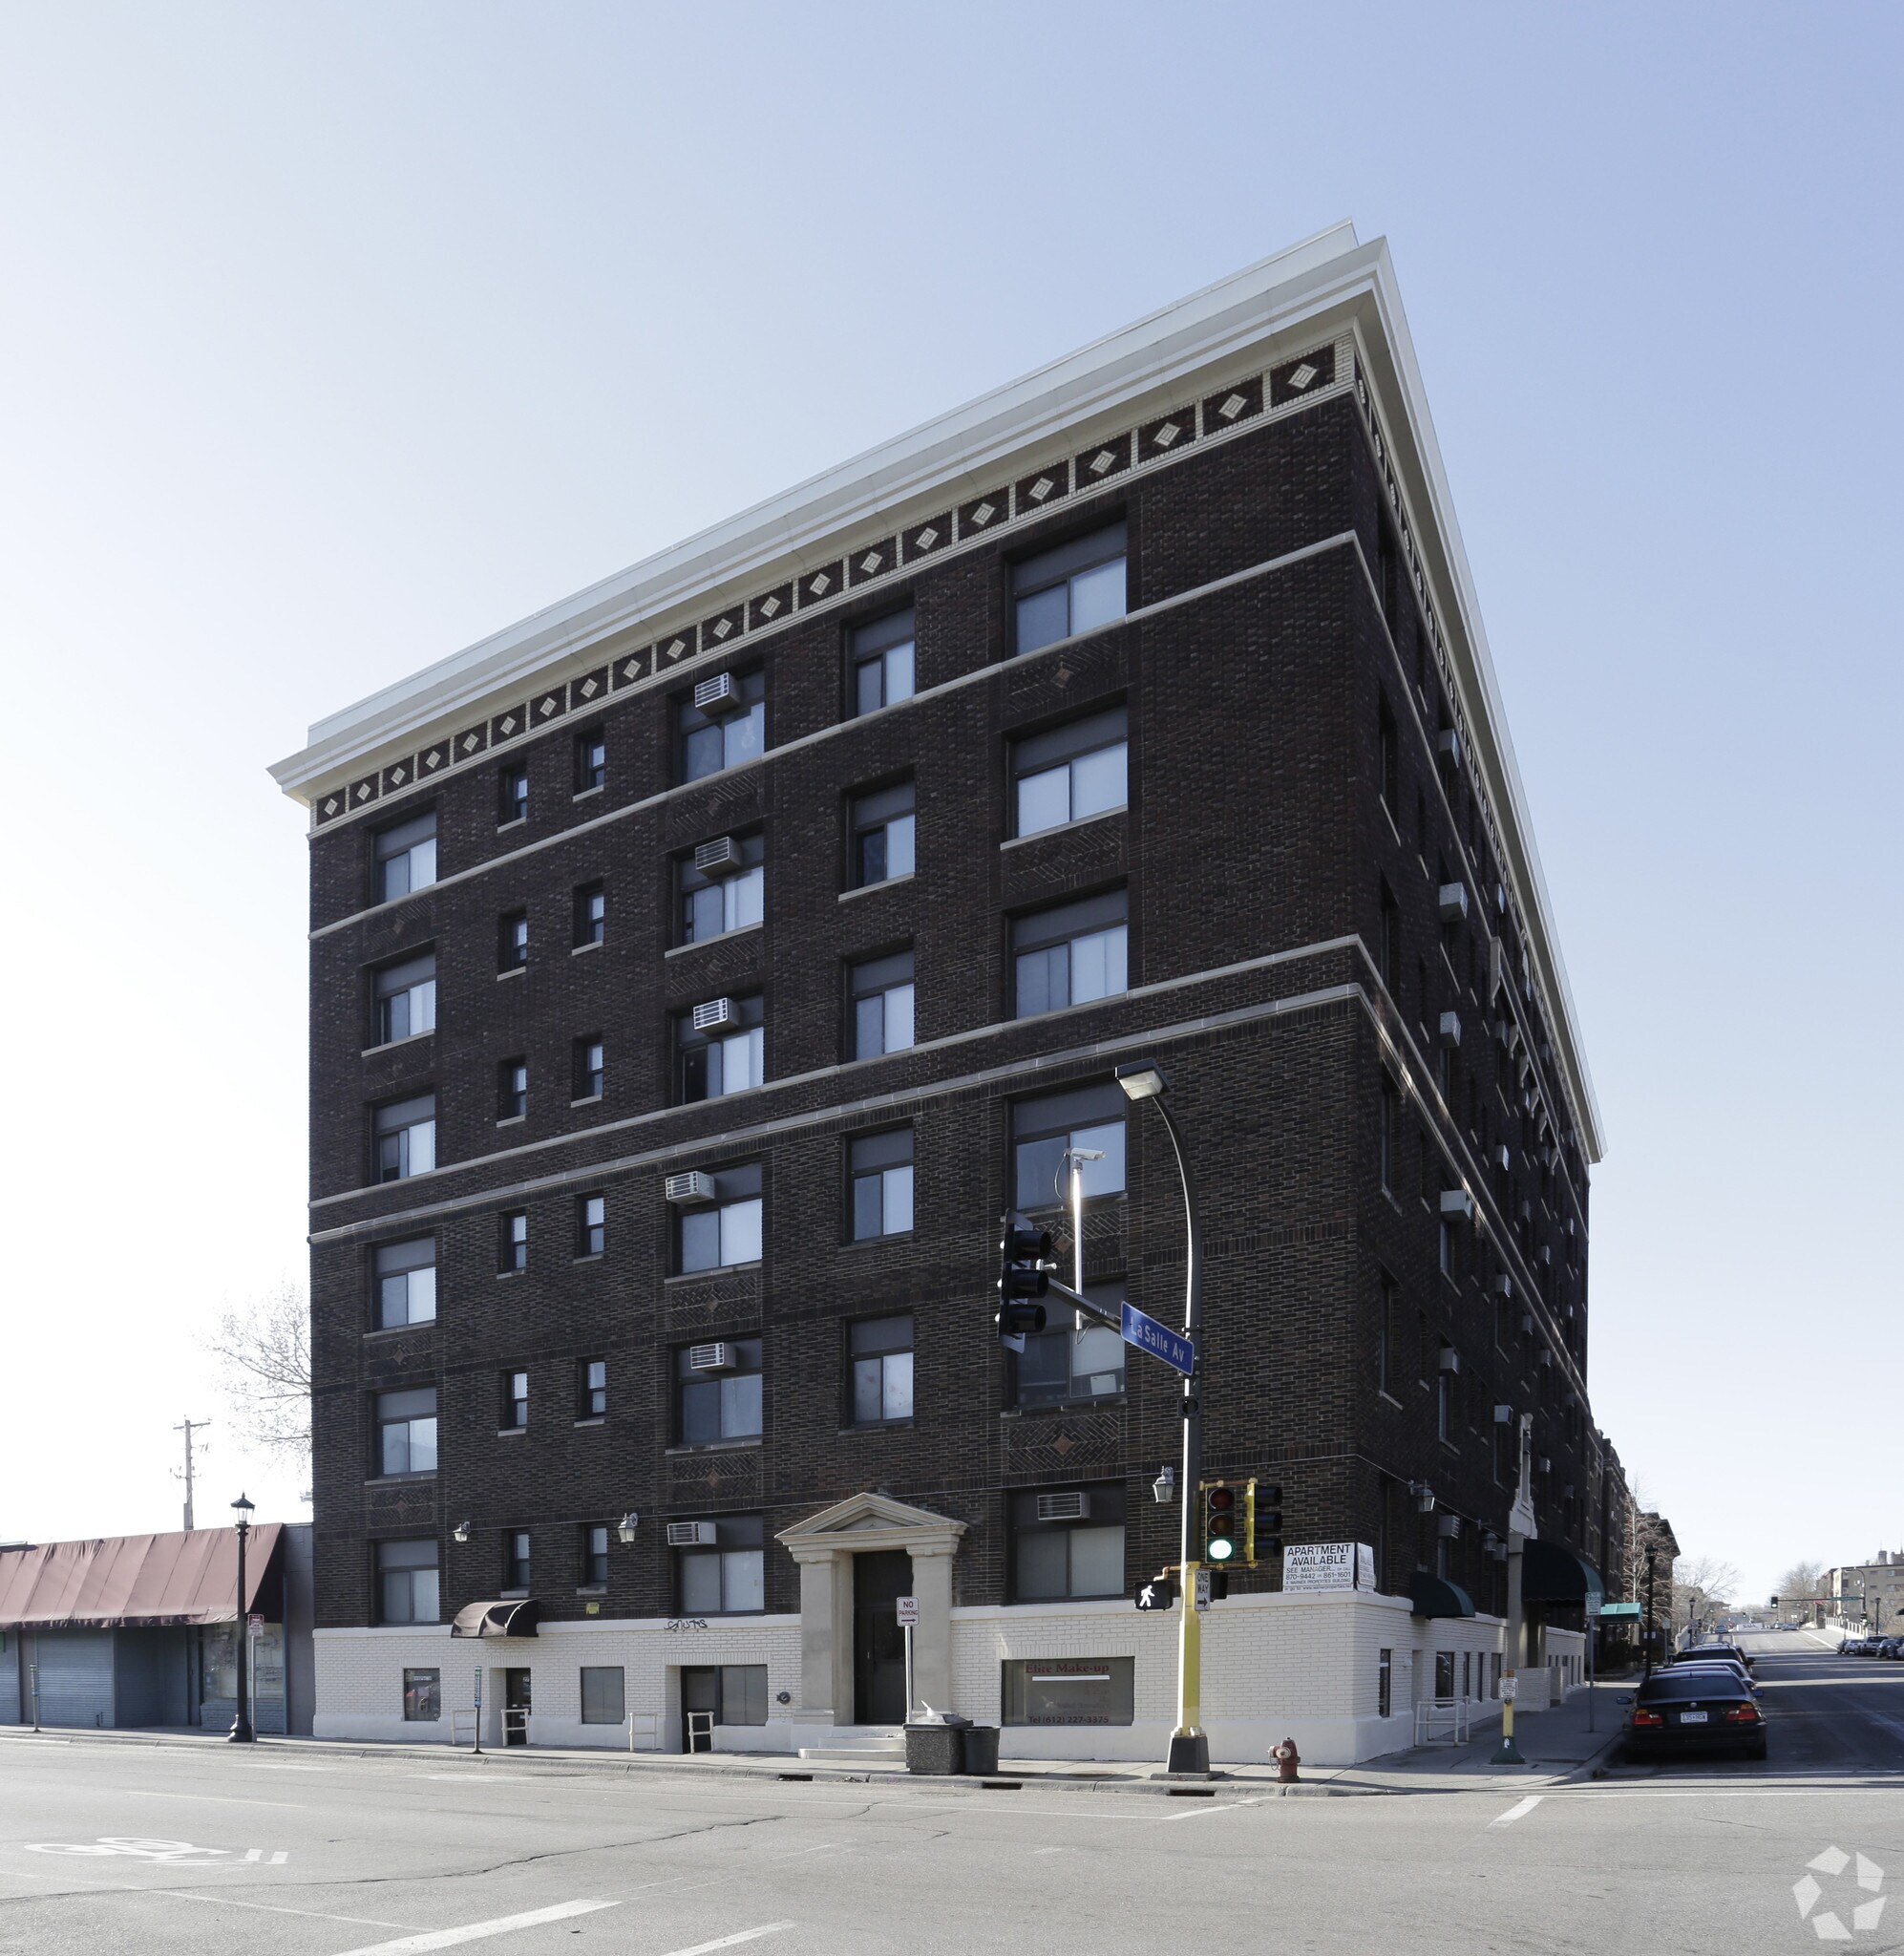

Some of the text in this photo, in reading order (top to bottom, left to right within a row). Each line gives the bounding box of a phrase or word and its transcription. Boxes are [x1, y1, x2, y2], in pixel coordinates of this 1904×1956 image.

[1173, 1342, 1184, 1362] Av
[1287, 1544, 1351, 1556] APARTMENT
[1291, 1555, 1346, 1566] AVAILABLE
[1197, 1572, 1208, 1583] ONE
[1197, 1584, 1208, 1594] WAY
[1026, 1663, 1110, 1674] Elite Make-up
[1043, 1715, 1065, 1724] (612)
[1068, 1715, 1110, 1724] 227-3375
